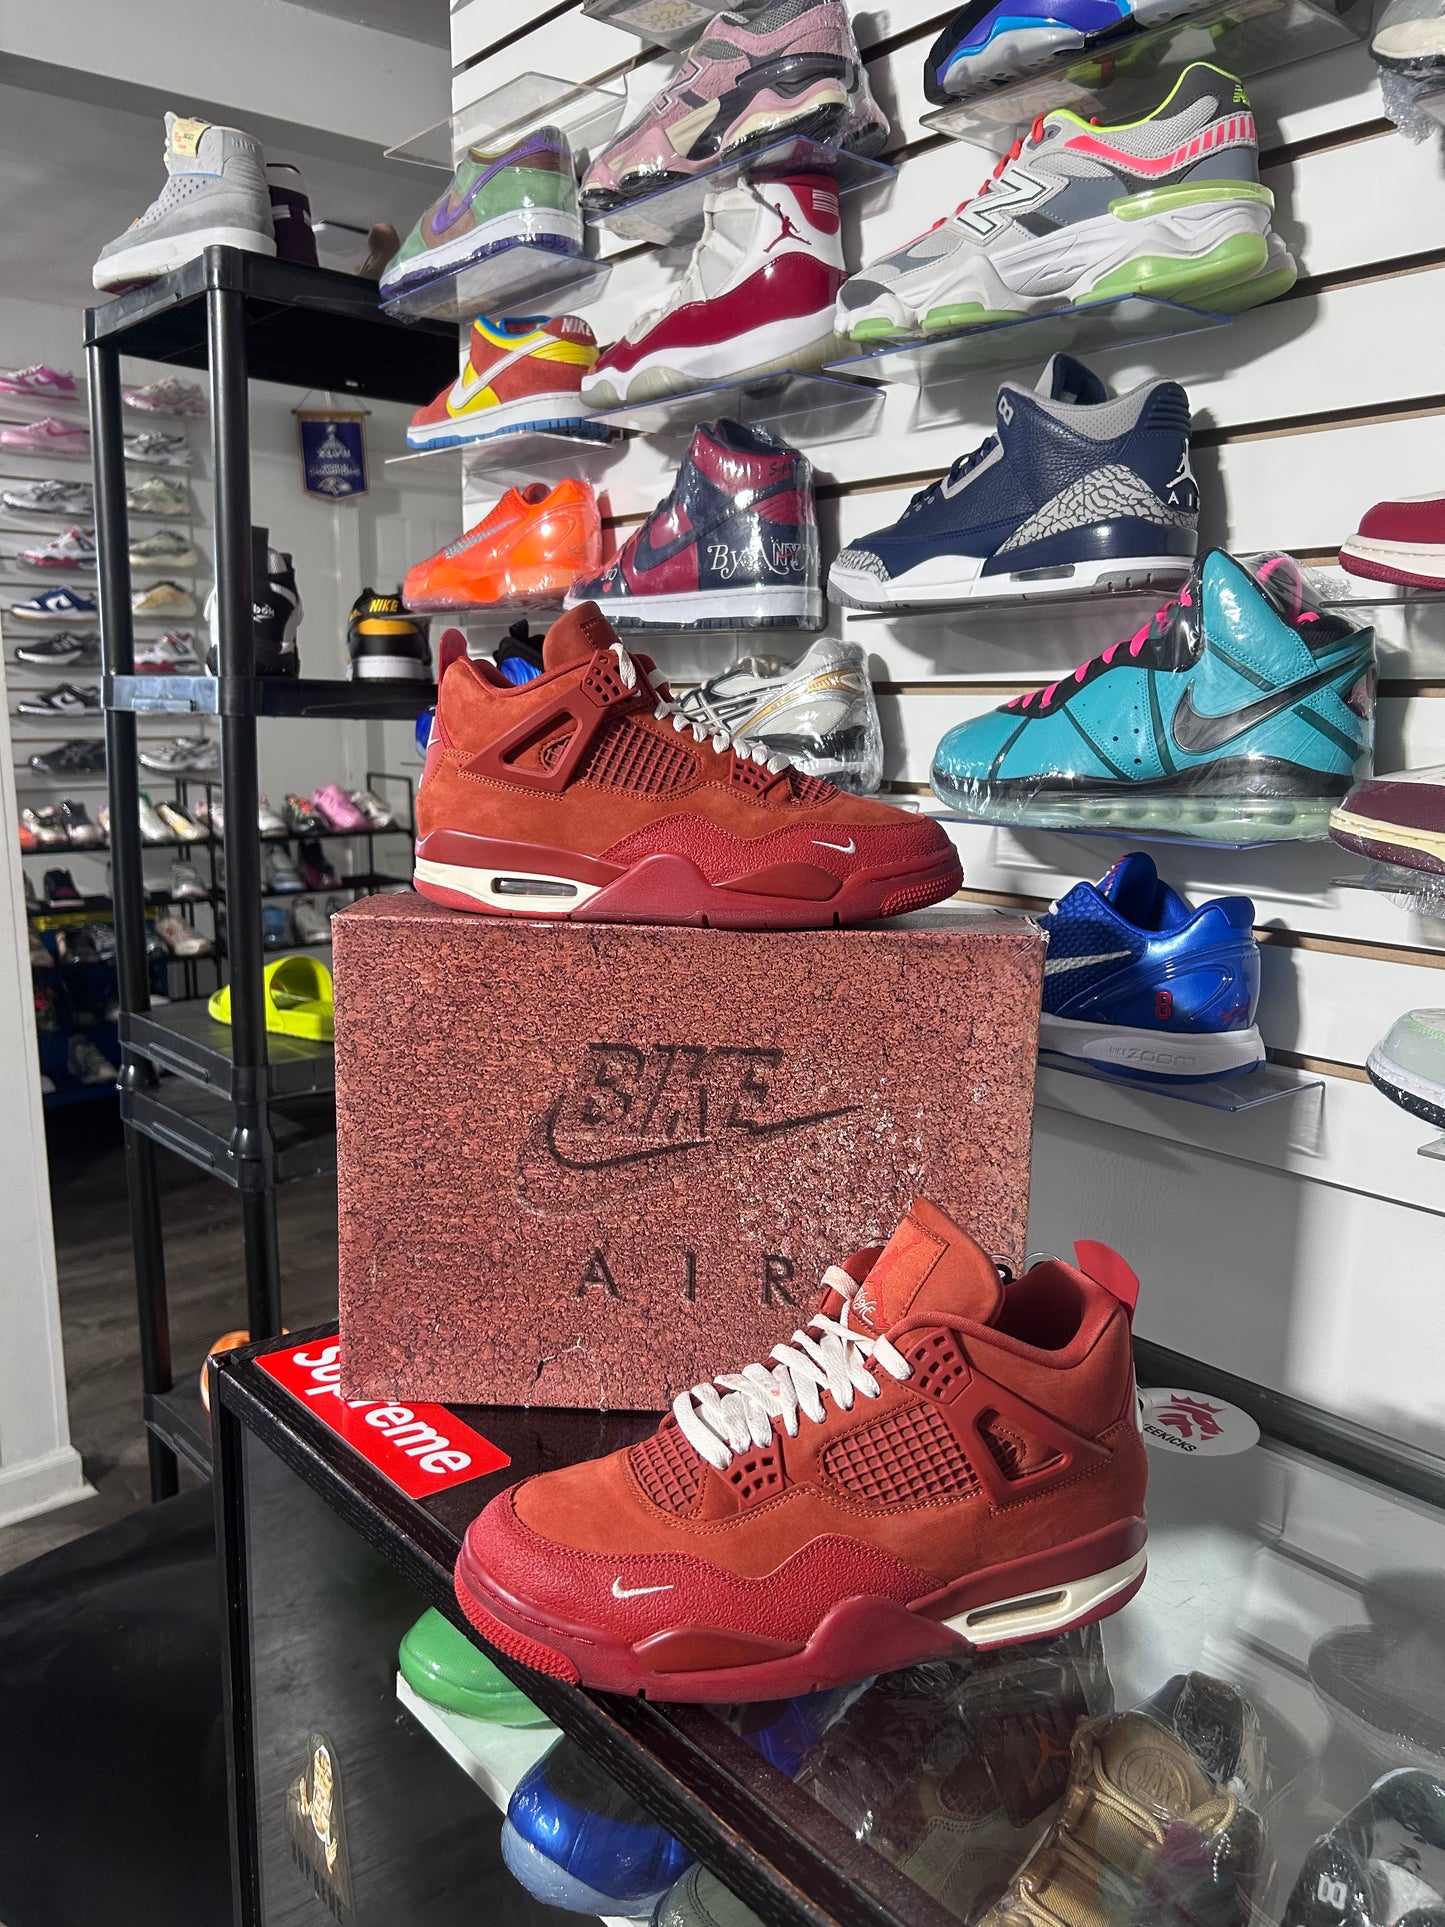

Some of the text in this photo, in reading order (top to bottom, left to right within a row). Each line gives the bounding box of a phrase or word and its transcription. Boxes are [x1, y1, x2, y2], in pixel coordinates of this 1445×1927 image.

[561, 317, 593, 336] NIKE
[369, 598, 400, 613] NIKE
[1155, 991, 1173, 1021] 8
[576, 1246, 803, 1306] AIR
